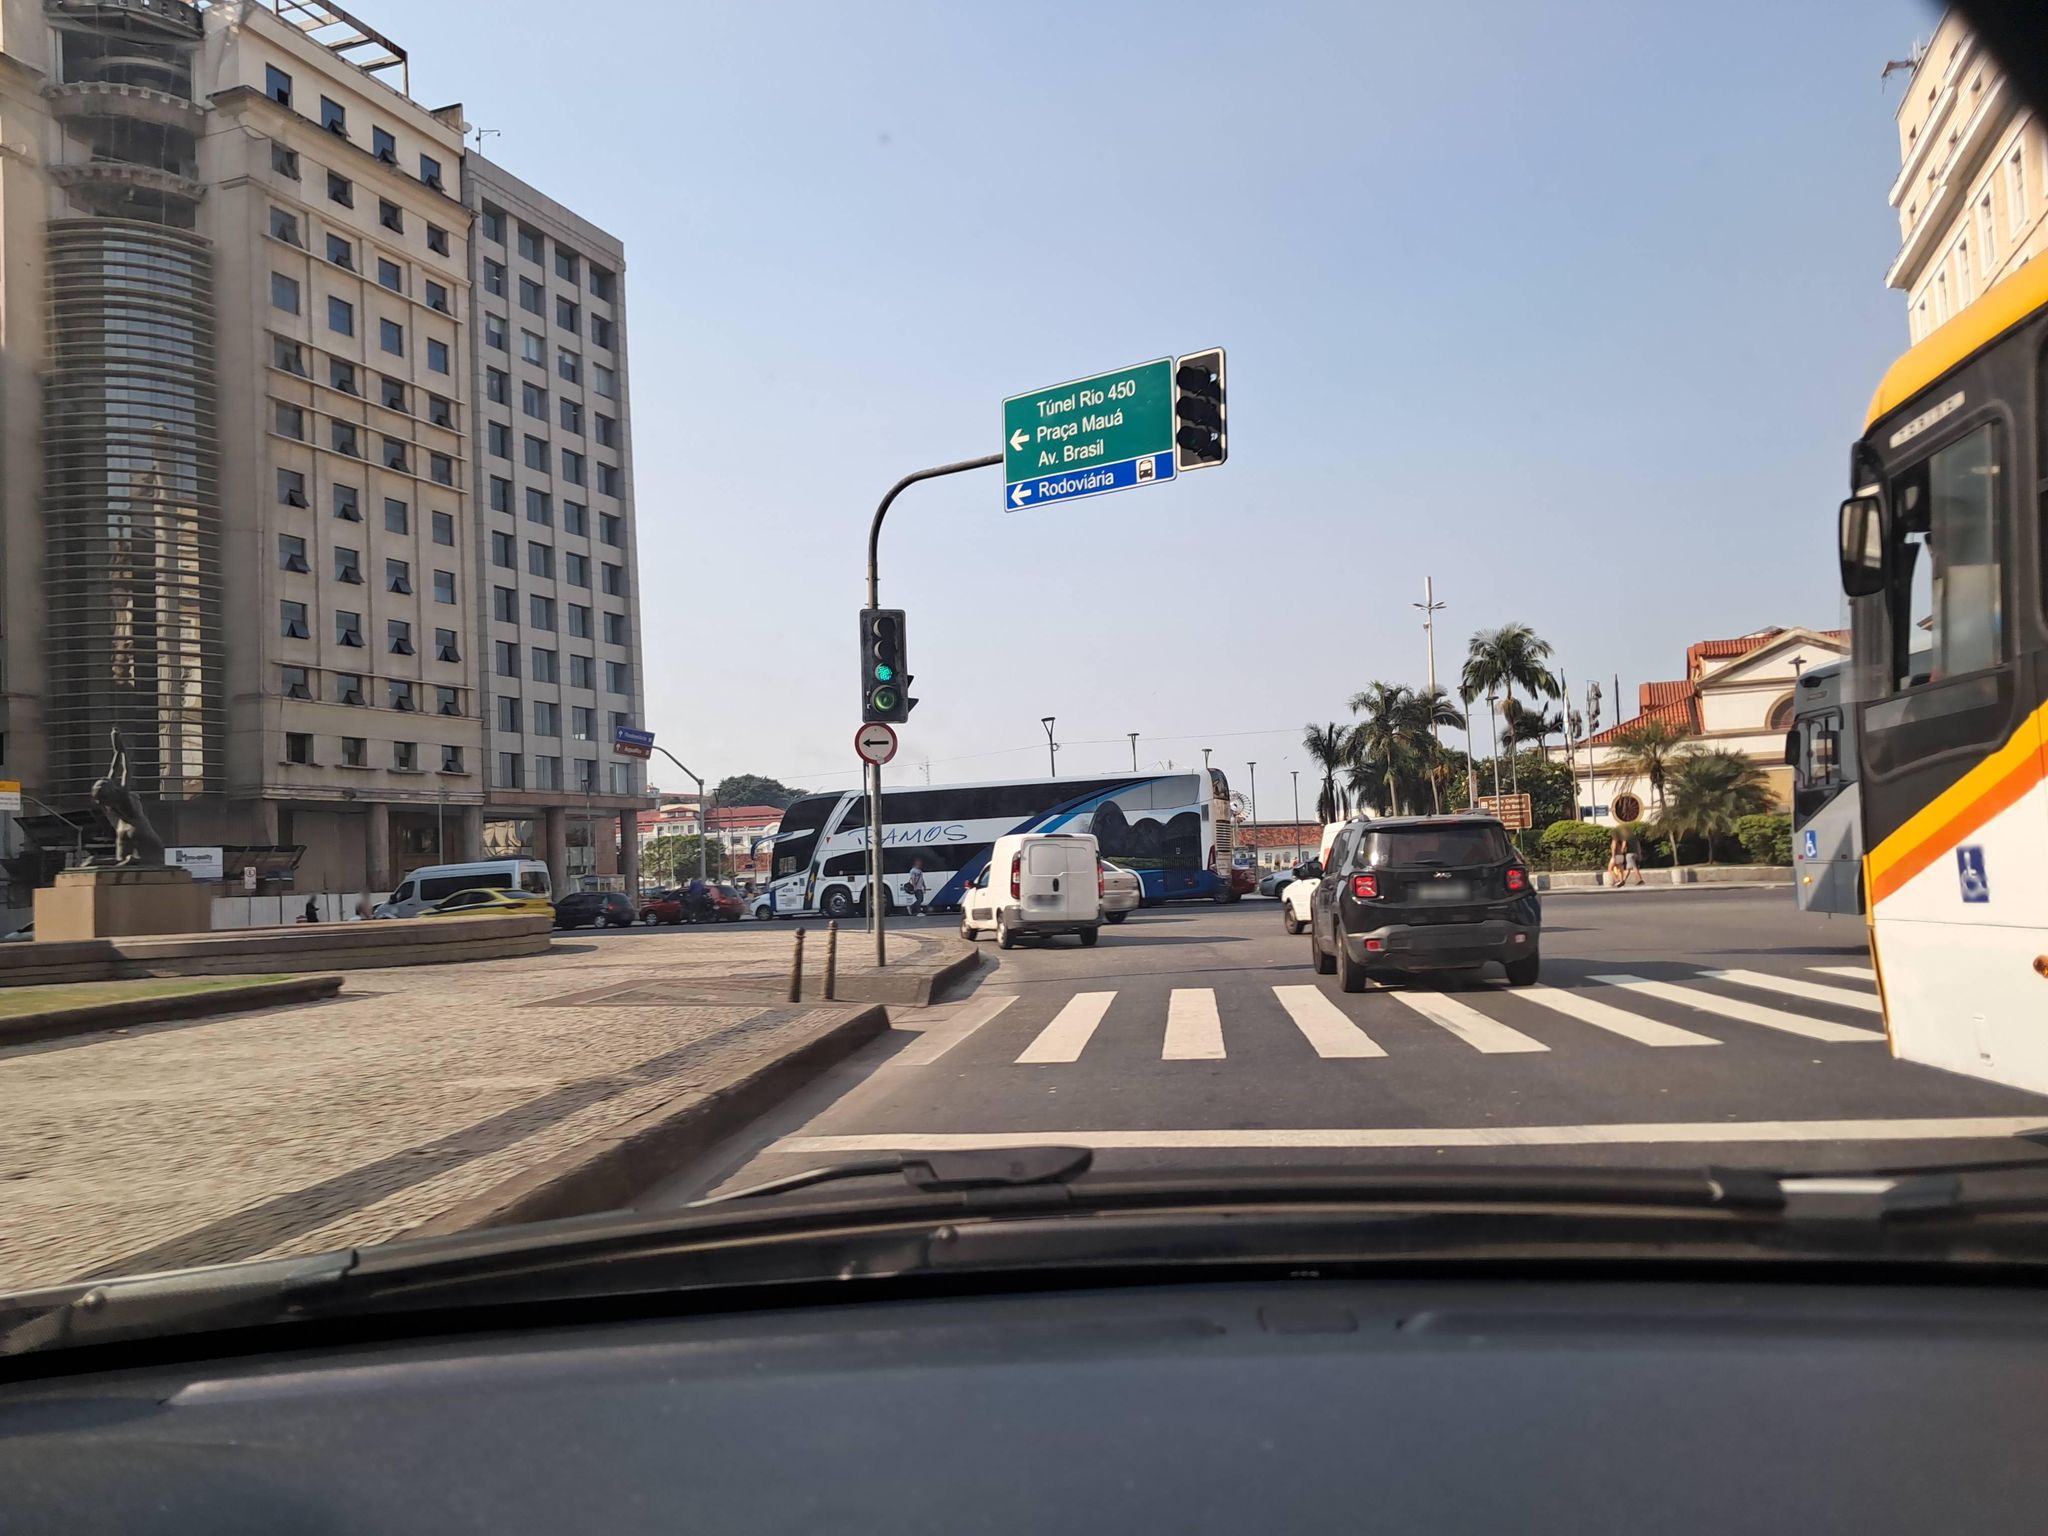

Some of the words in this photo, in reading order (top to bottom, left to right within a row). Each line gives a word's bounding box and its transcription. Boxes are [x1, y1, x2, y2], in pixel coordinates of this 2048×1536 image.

[1037, 394, 1076, 418] Túnel
[1079, 388, 1104, 406] Rio
[1107, 379, 1136, 400] 450
[1037, 423, 1078, 442] Praça
[1082, 409, 1123, 433] Mauá
[1038, 450, 1059, 468] Av.
[1063, 439, 1104, 461] Brasil
[1038, 471, 1114, 498] Rodoviária
